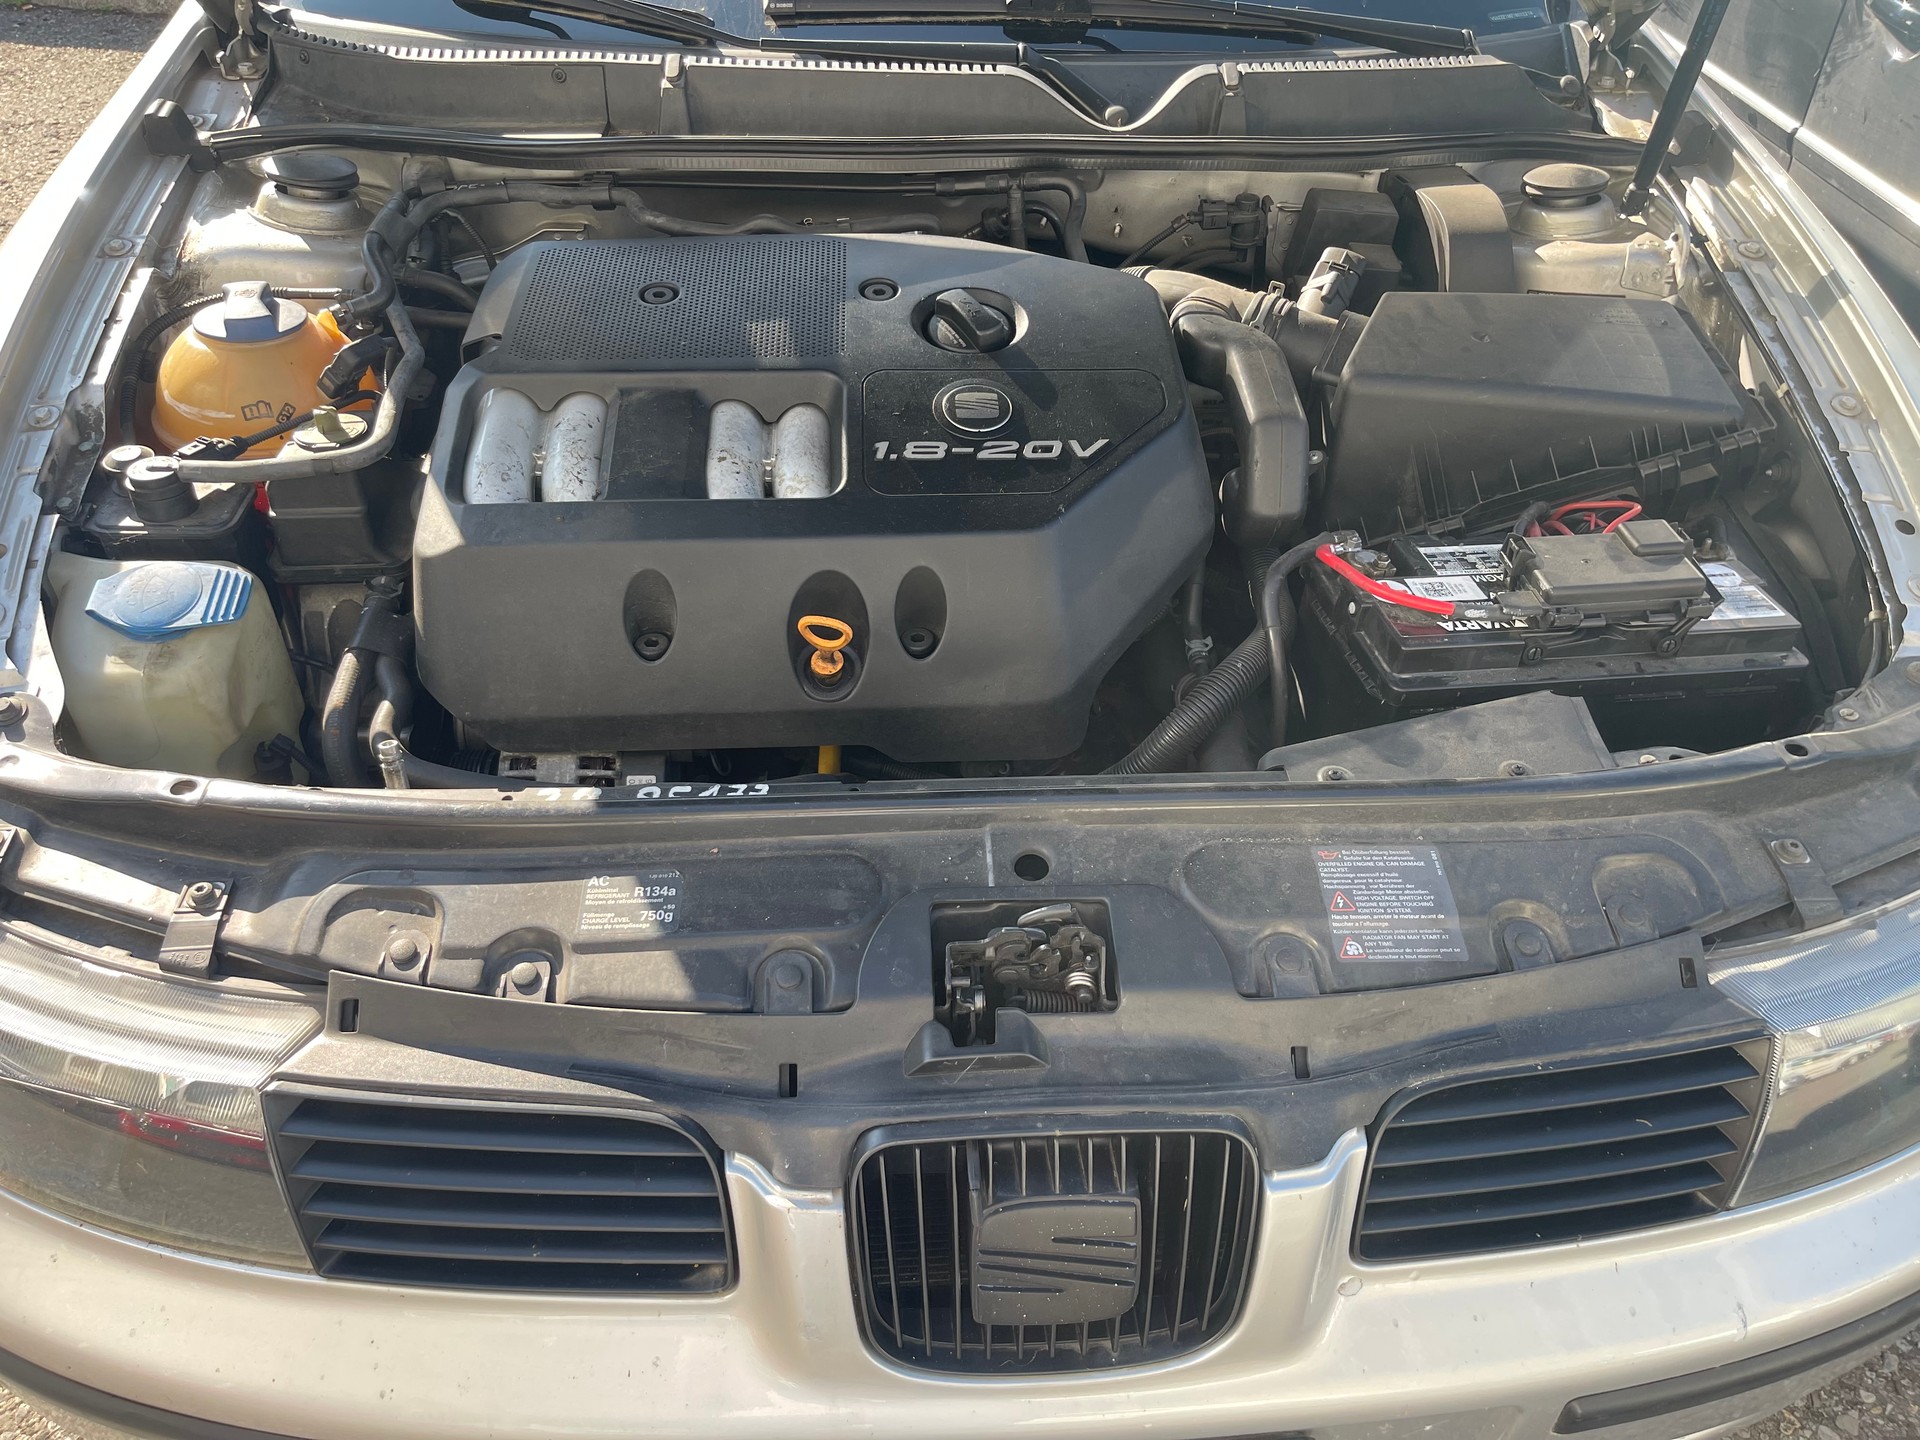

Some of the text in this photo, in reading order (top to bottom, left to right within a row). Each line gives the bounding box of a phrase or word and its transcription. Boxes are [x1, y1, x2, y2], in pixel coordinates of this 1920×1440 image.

[279, 406, 294, 423] G12
[873, 438, 1110, 460] 1.8-20V
[1472, 574, 1504, 583] AGM
[588, 876, 610, 886] AC
[634, 886, 676, 897] R134a
[640, 910, 674, 922] 750g
